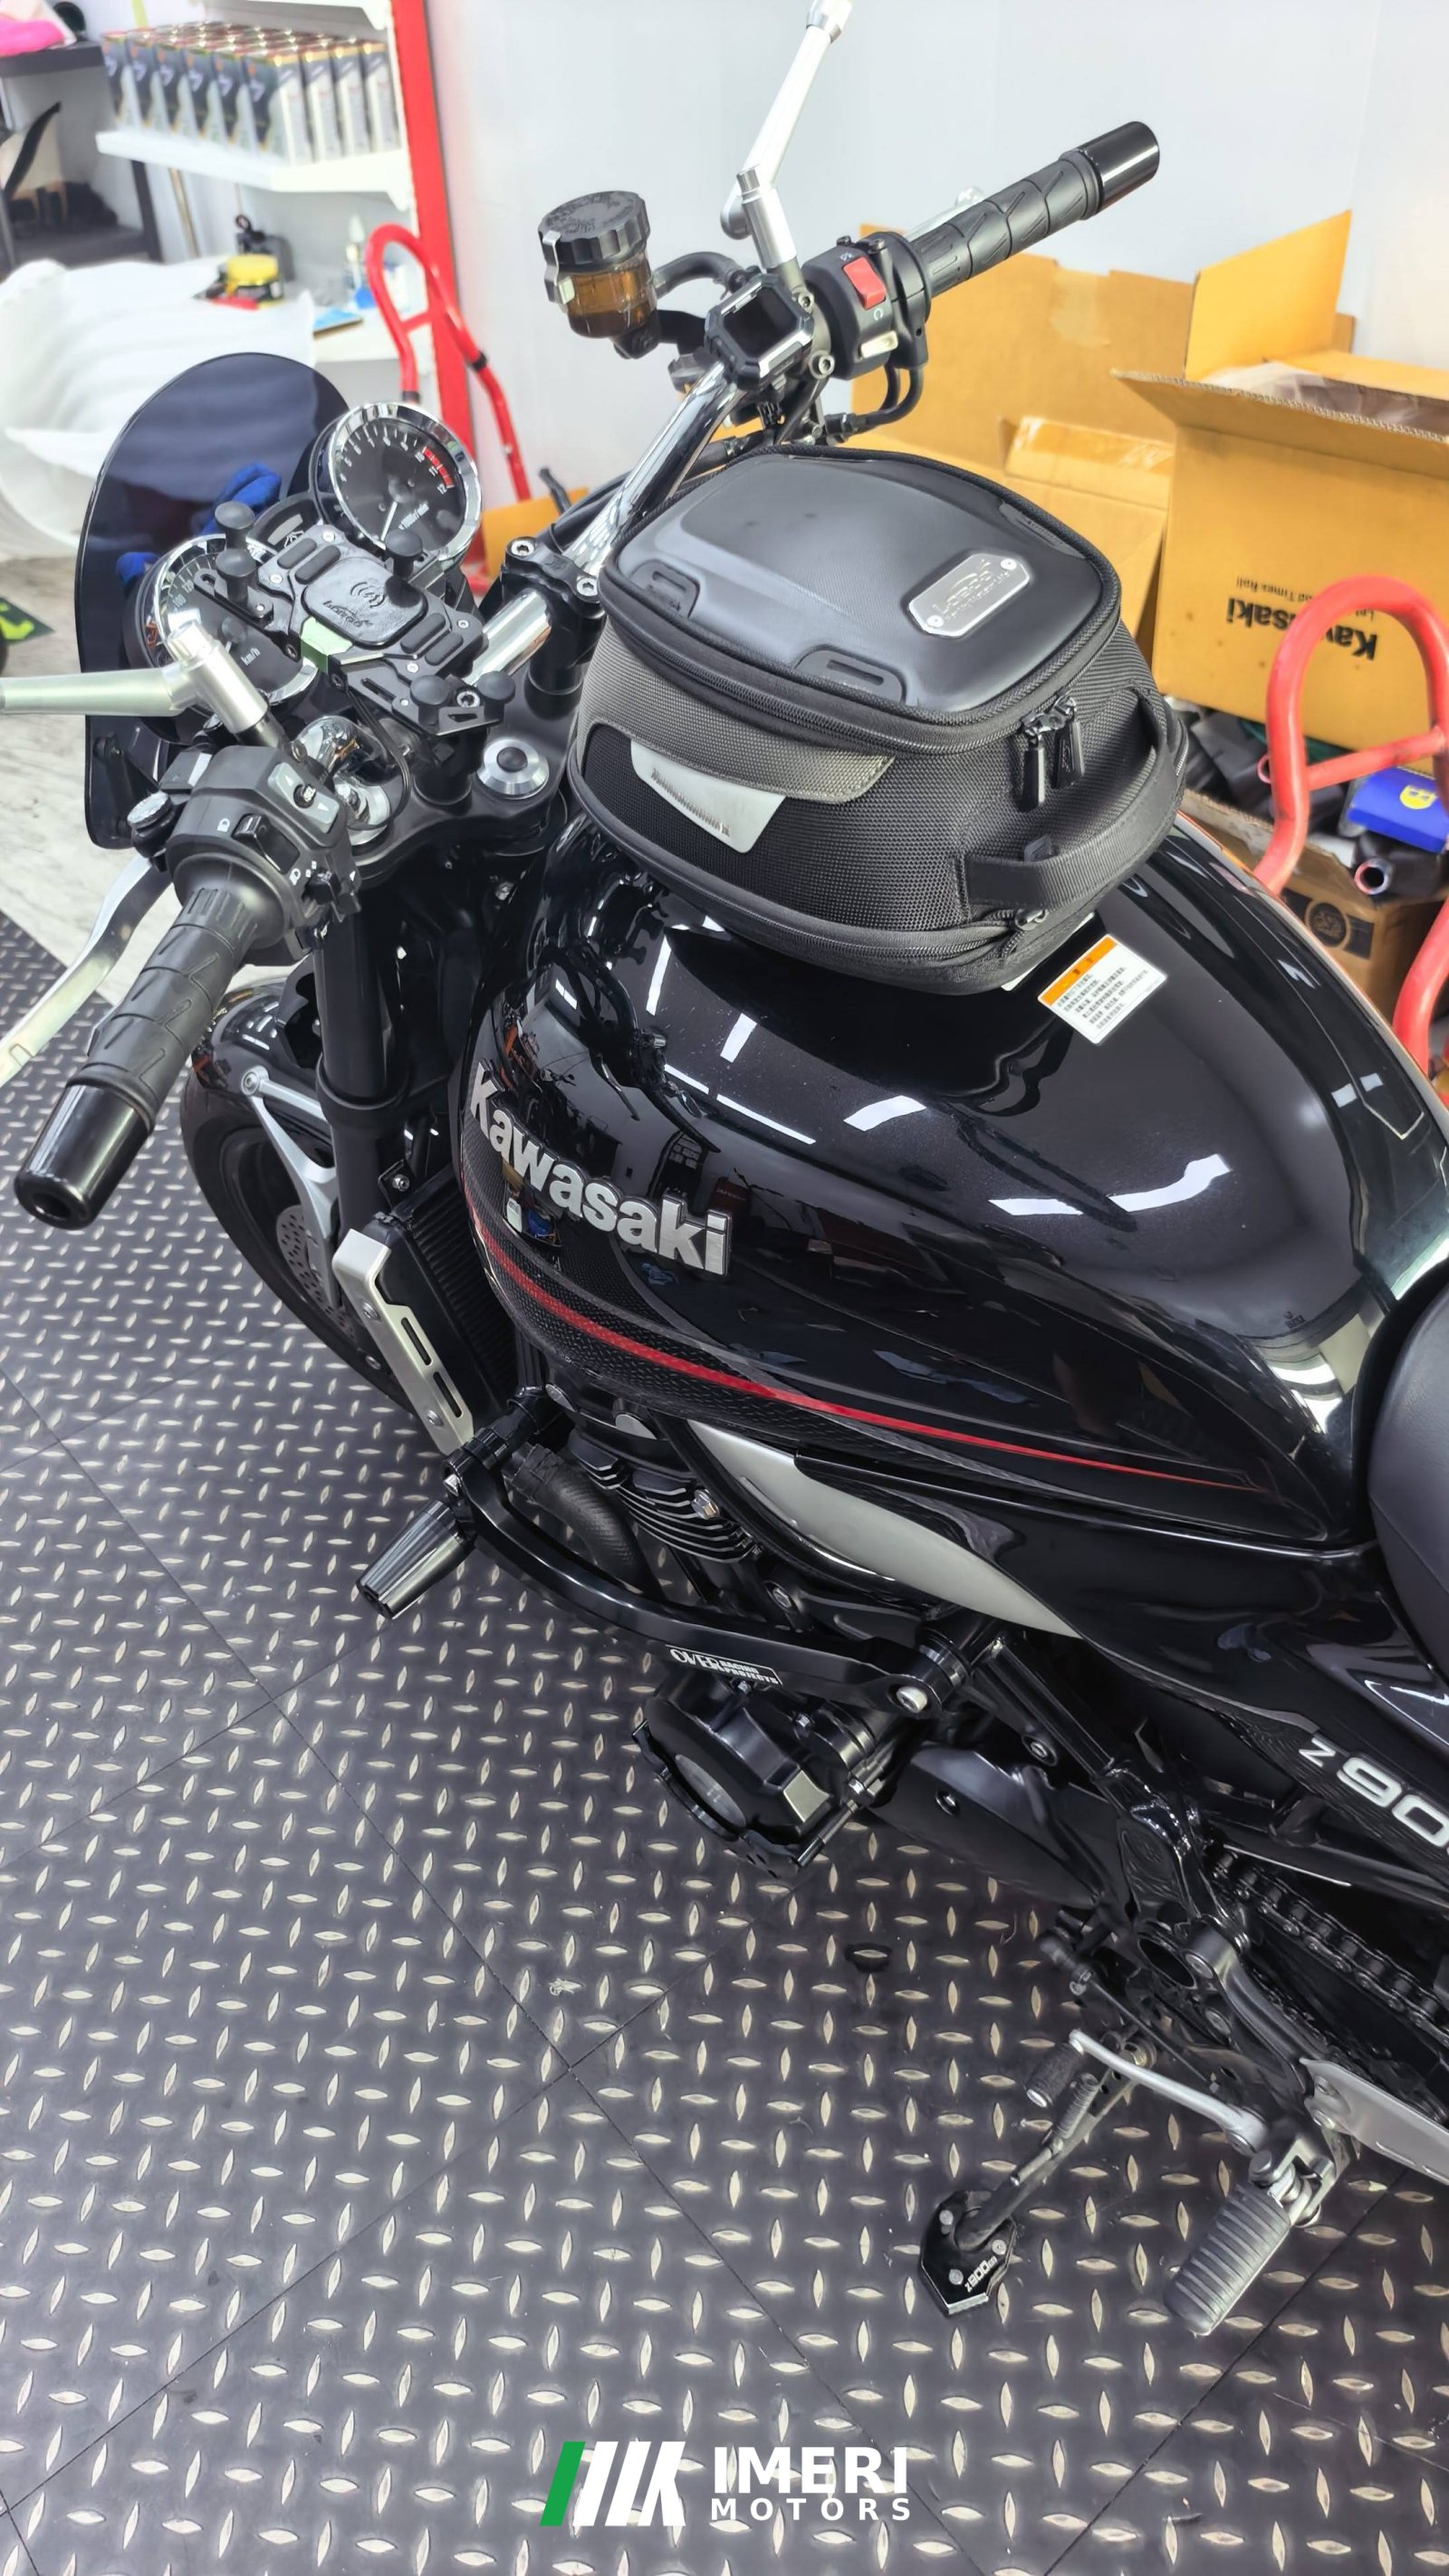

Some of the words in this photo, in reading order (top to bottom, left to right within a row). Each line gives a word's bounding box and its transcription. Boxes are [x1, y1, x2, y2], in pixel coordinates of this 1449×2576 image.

[428, 466, 438, 476] 11
[437, 484, 447, 495] 12
[1226, 598, 1377, 661] Kasaki
[241, 647, 261, 666] km/h
[469, 1060, 728, 1275] Kawasaki
[670, 1648, 725, 1672] OVER
